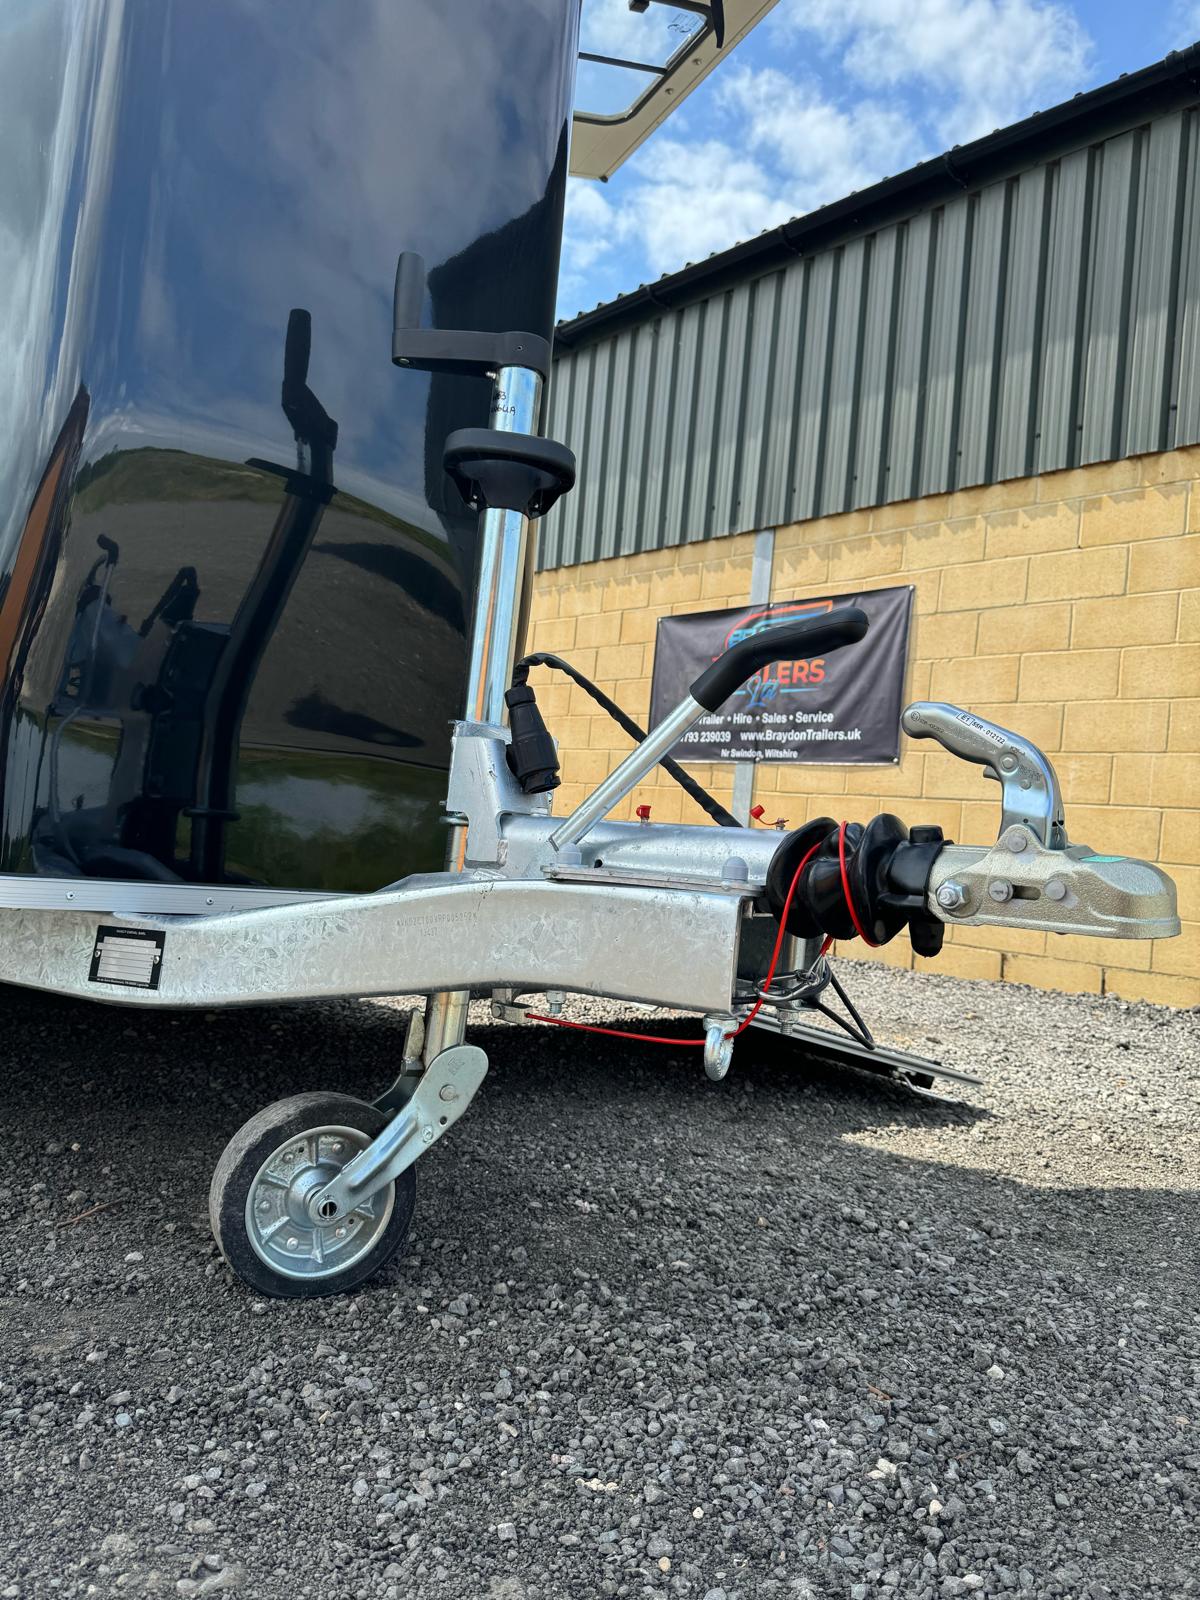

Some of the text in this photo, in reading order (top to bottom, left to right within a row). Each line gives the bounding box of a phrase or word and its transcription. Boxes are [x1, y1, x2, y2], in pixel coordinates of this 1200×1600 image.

[733, 713, 753, 724] Hire
[762, 712, 788, 724] Sales
[795, 711, 834, 723] Service
[680, 728, 862, 743] 793 239039 www.BraydonTrailers.uk
[720, 748, 798, 759] Nr Swindon, Wiltshire
